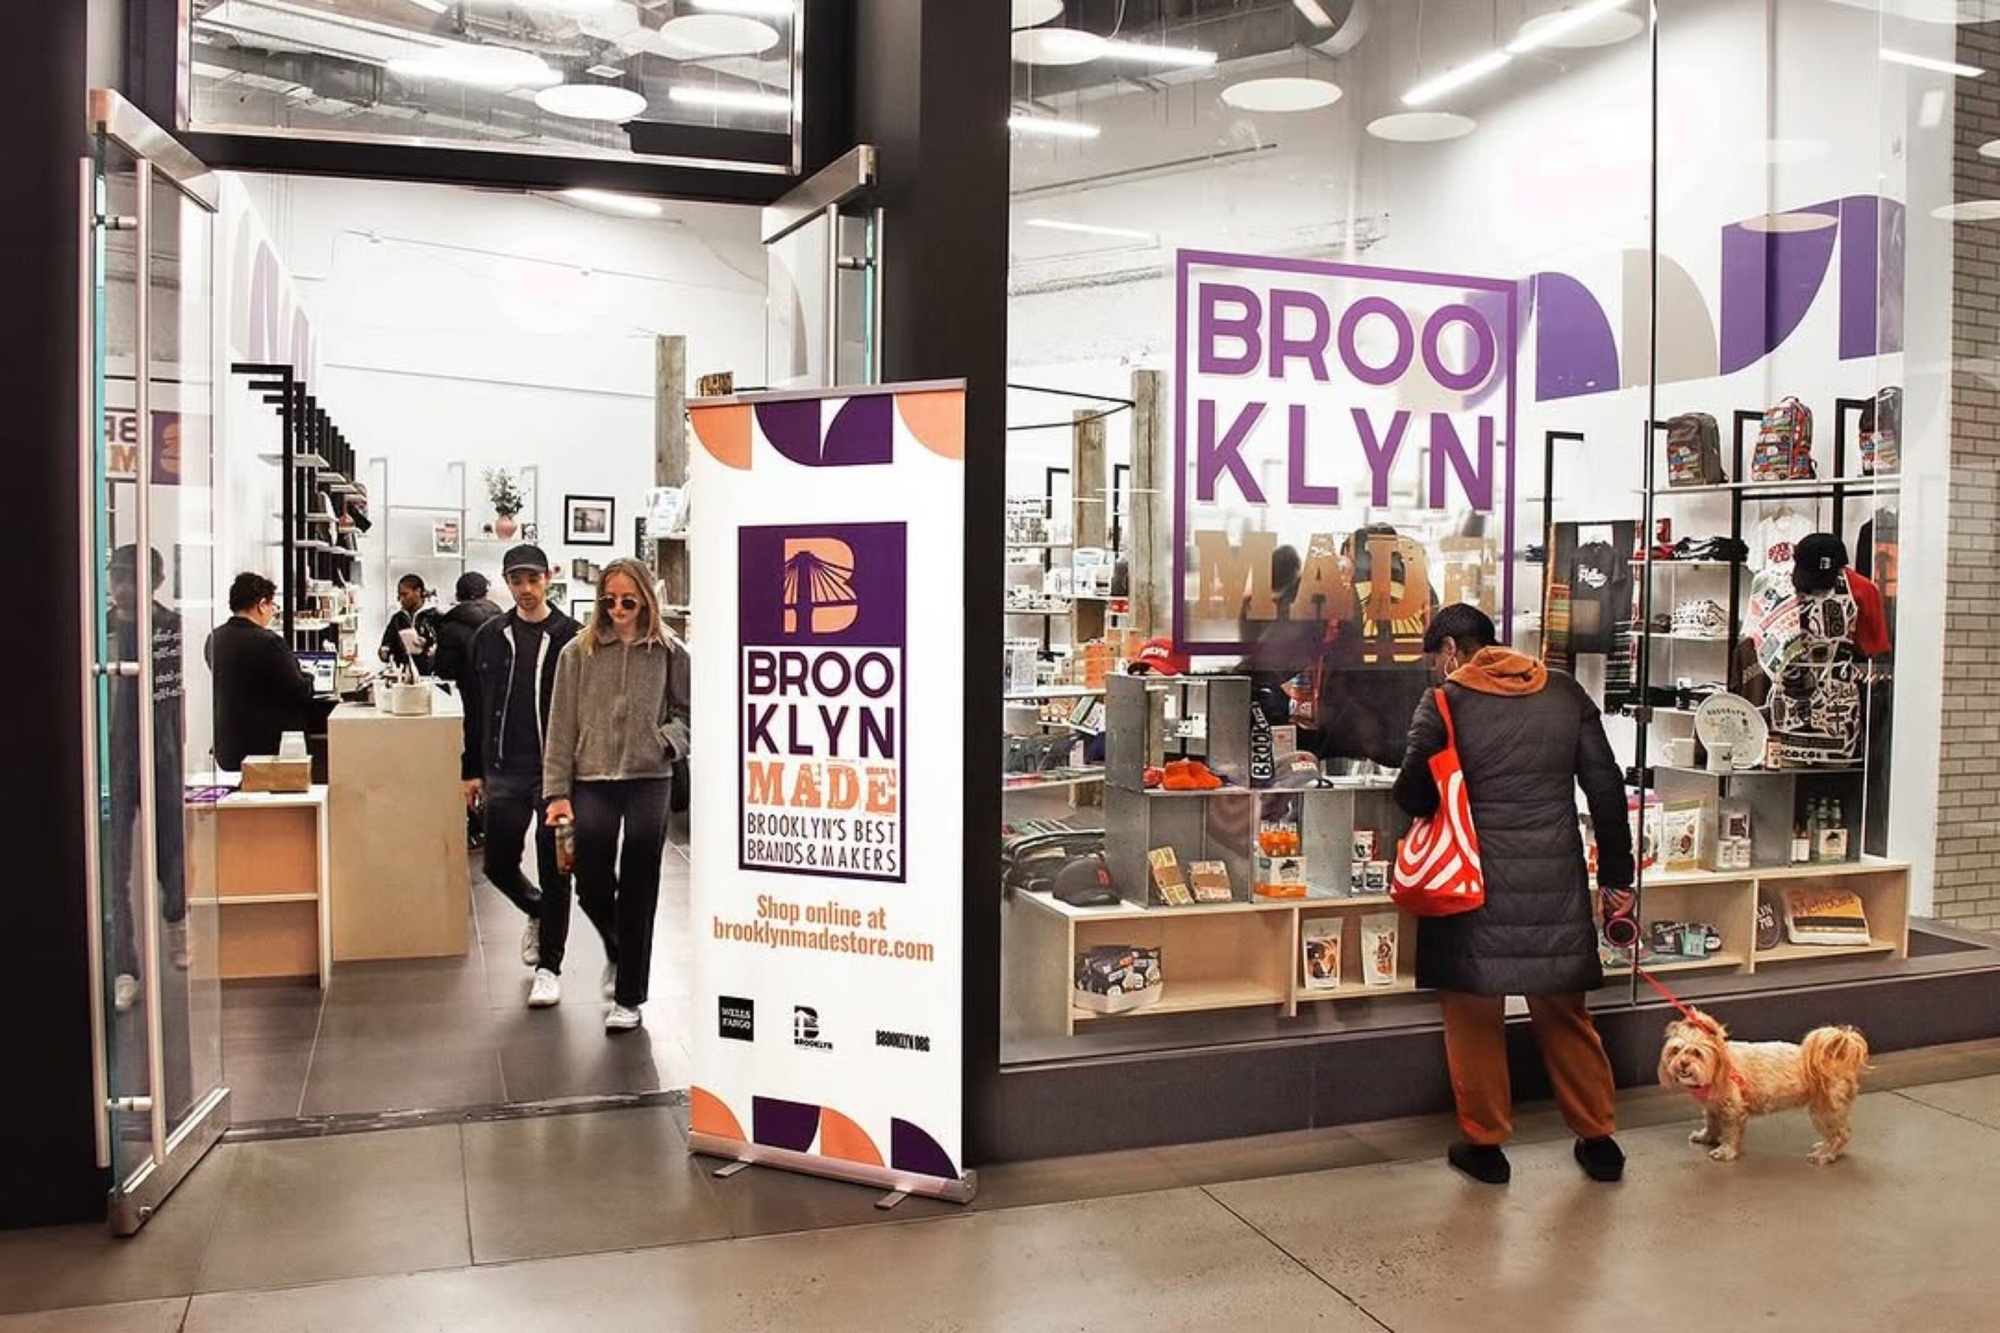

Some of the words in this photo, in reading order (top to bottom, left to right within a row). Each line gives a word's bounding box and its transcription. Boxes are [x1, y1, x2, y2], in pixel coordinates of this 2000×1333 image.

[1198, 282, 1495, 391] BROO
[1196, 399, 1494, 511] KLYN
[1194, 530, 1497, 621] MADE
[747, 651, 894, 698] BROO
[747, 703, 895, 759] KLYN
[747, 759, 897, 815] MADE
[747, 812, 848, 842] BROOKLYN'S
[854, 819, 897, 845] BEST
[713, 916, 935, 962] brooklynmadestore.com
[756, 894, 800, 923] Shop
[805, 902, 862, 928] online
[867, 907, 887, 930] at
